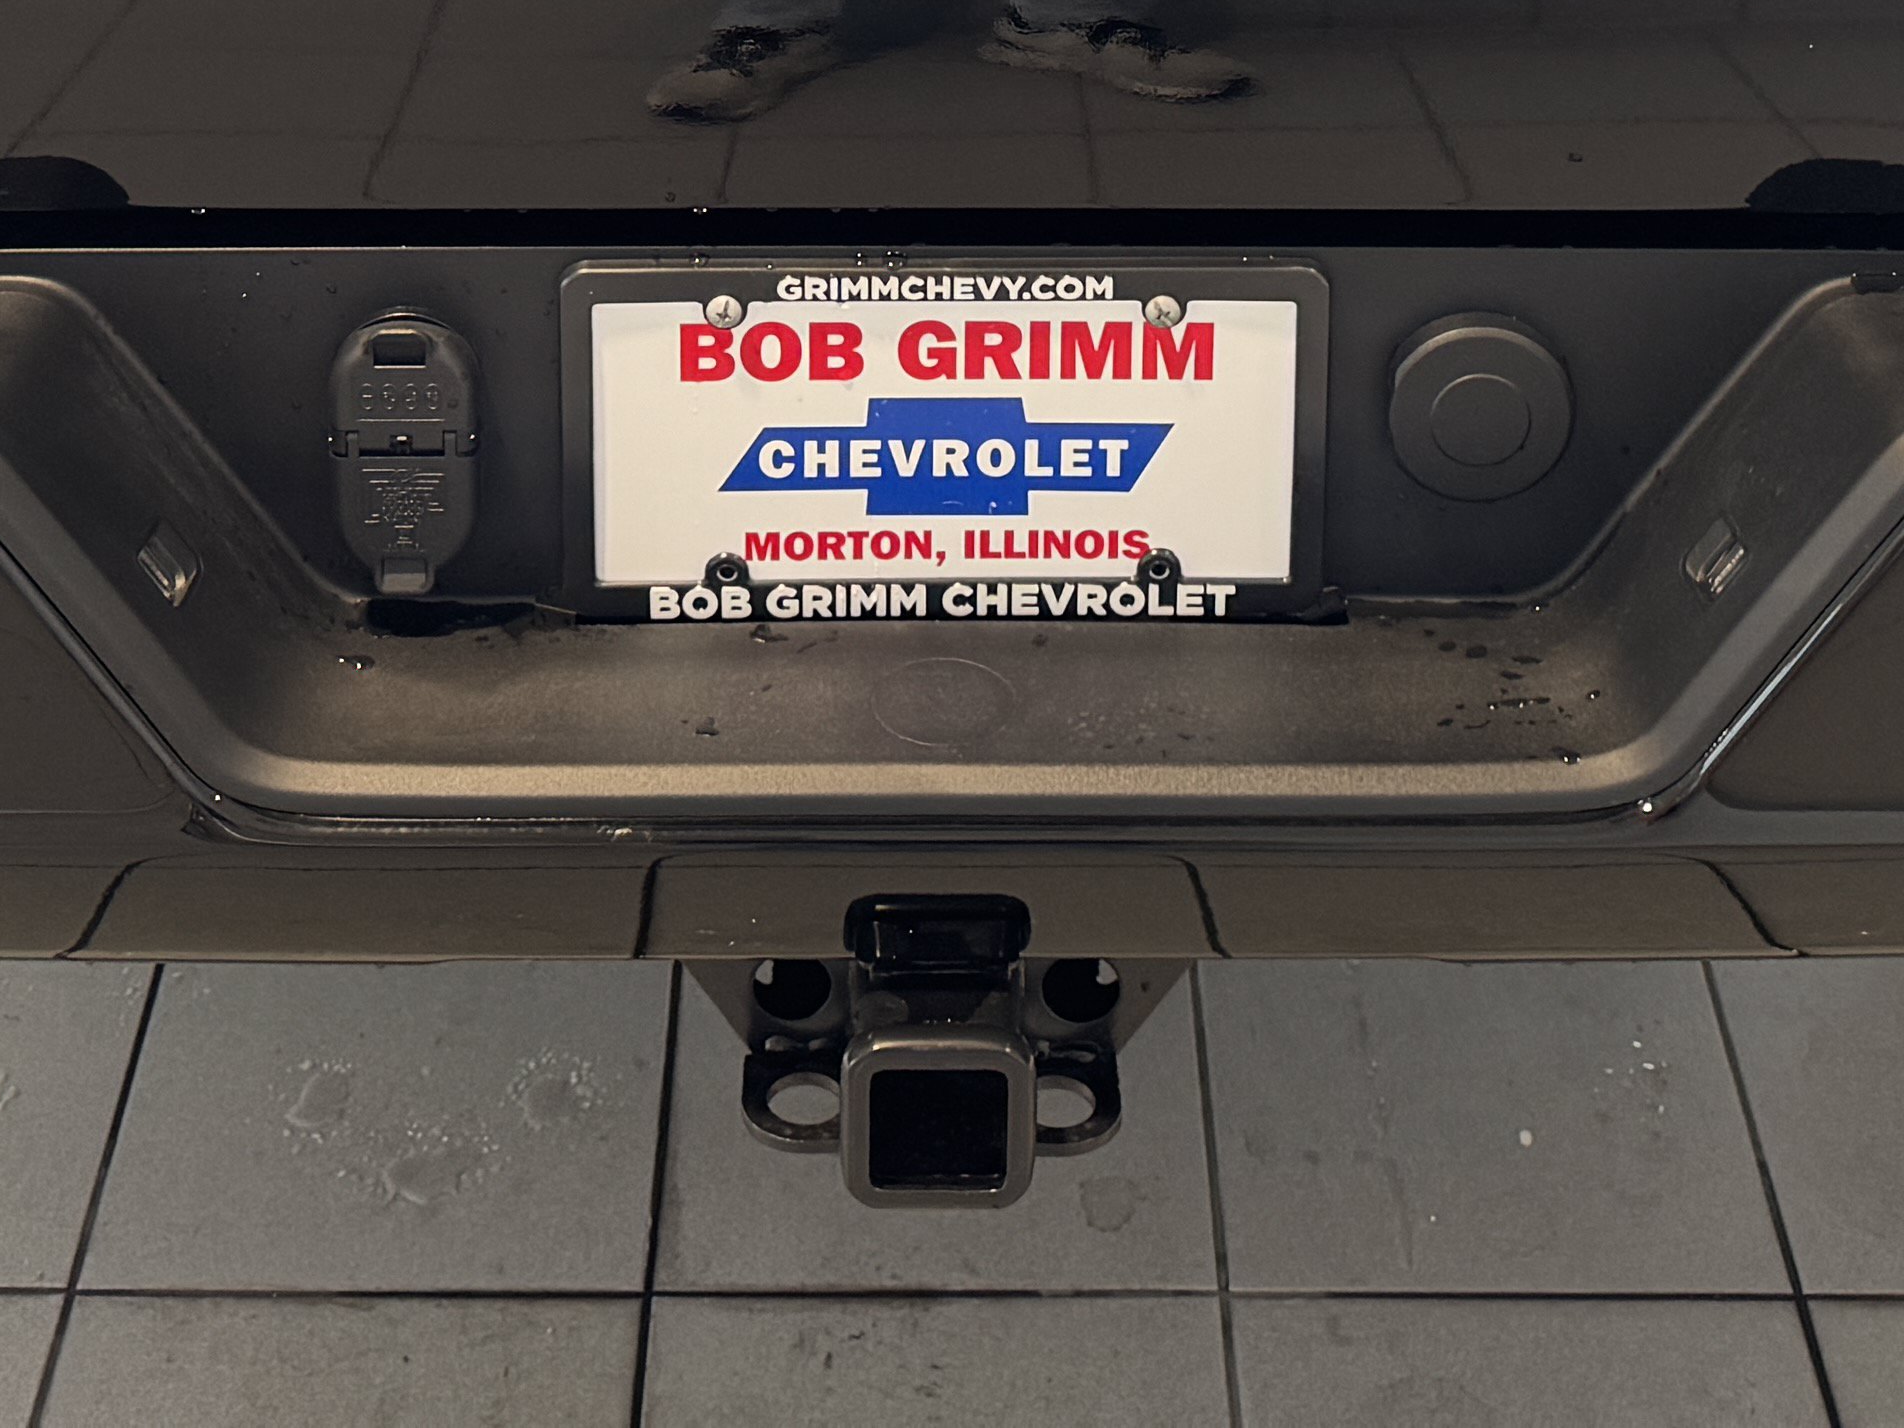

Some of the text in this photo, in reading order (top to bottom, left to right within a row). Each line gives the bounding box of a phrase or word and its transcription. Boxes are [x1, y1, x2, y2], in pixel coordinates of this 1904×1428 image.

[776, 274, 1114, 301] GRIMMCHEVY.COM
[679, 320, 1215, 383] BOB GRIMM
[757, 439, 1130, 480] CHEVROLET
[745, 529, 1151, 567] MORTON, ILLINOIS
[648, 581, 1237, 621] BOB GRIMM CHEVROLET
